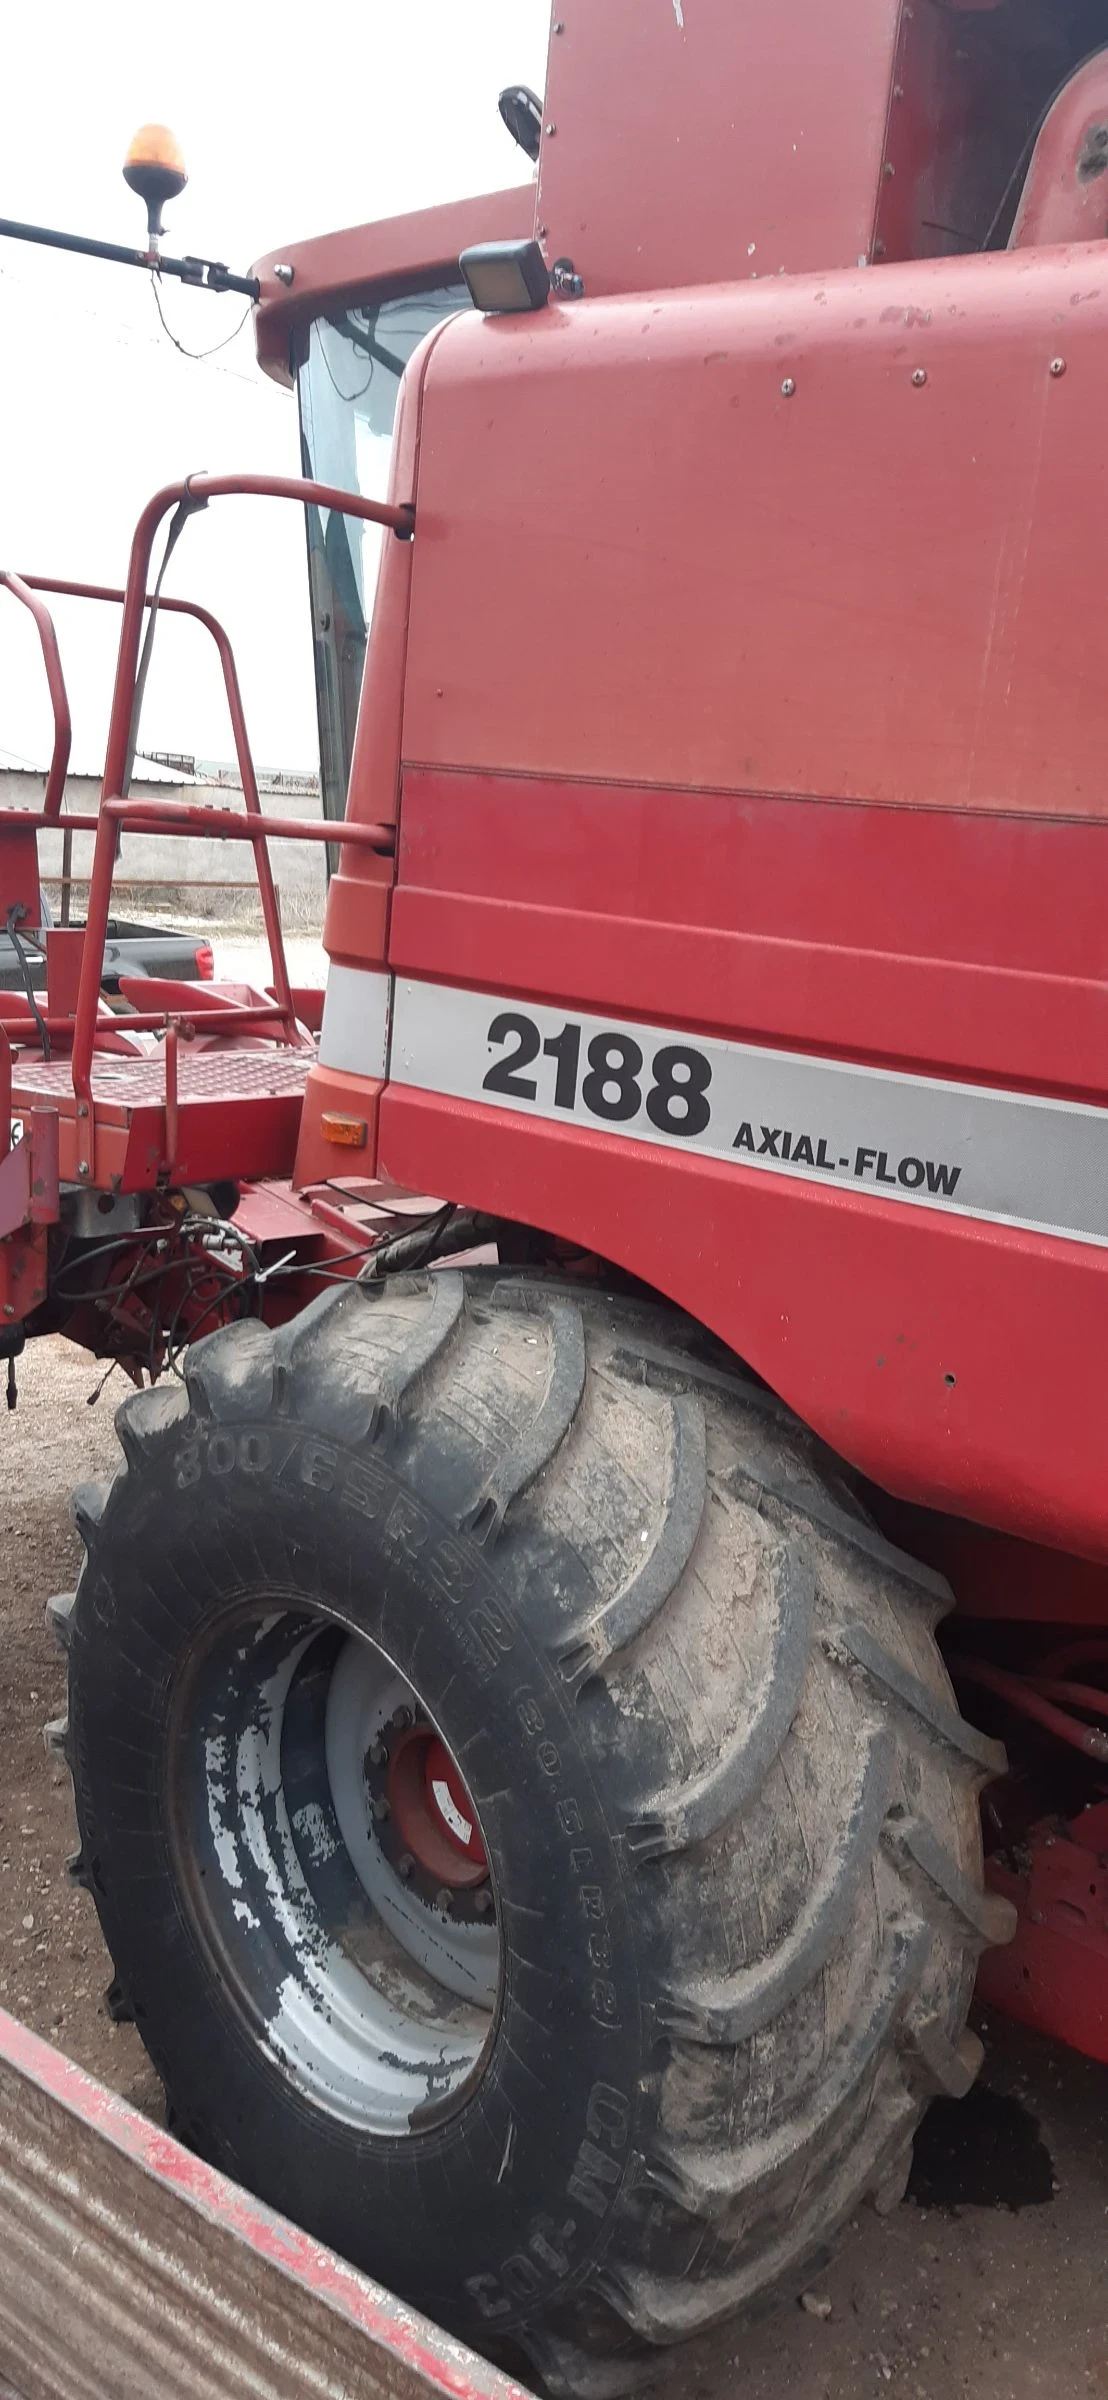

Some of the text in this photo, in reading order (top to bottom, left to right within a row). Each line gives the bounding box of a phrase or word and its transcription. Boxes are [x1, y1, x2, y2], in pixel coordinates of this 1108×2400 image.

[482, 1013, 962, 1197] 2188 AXIAL-FLOW
[173, 1430, 517, 1668] 800/65R32
